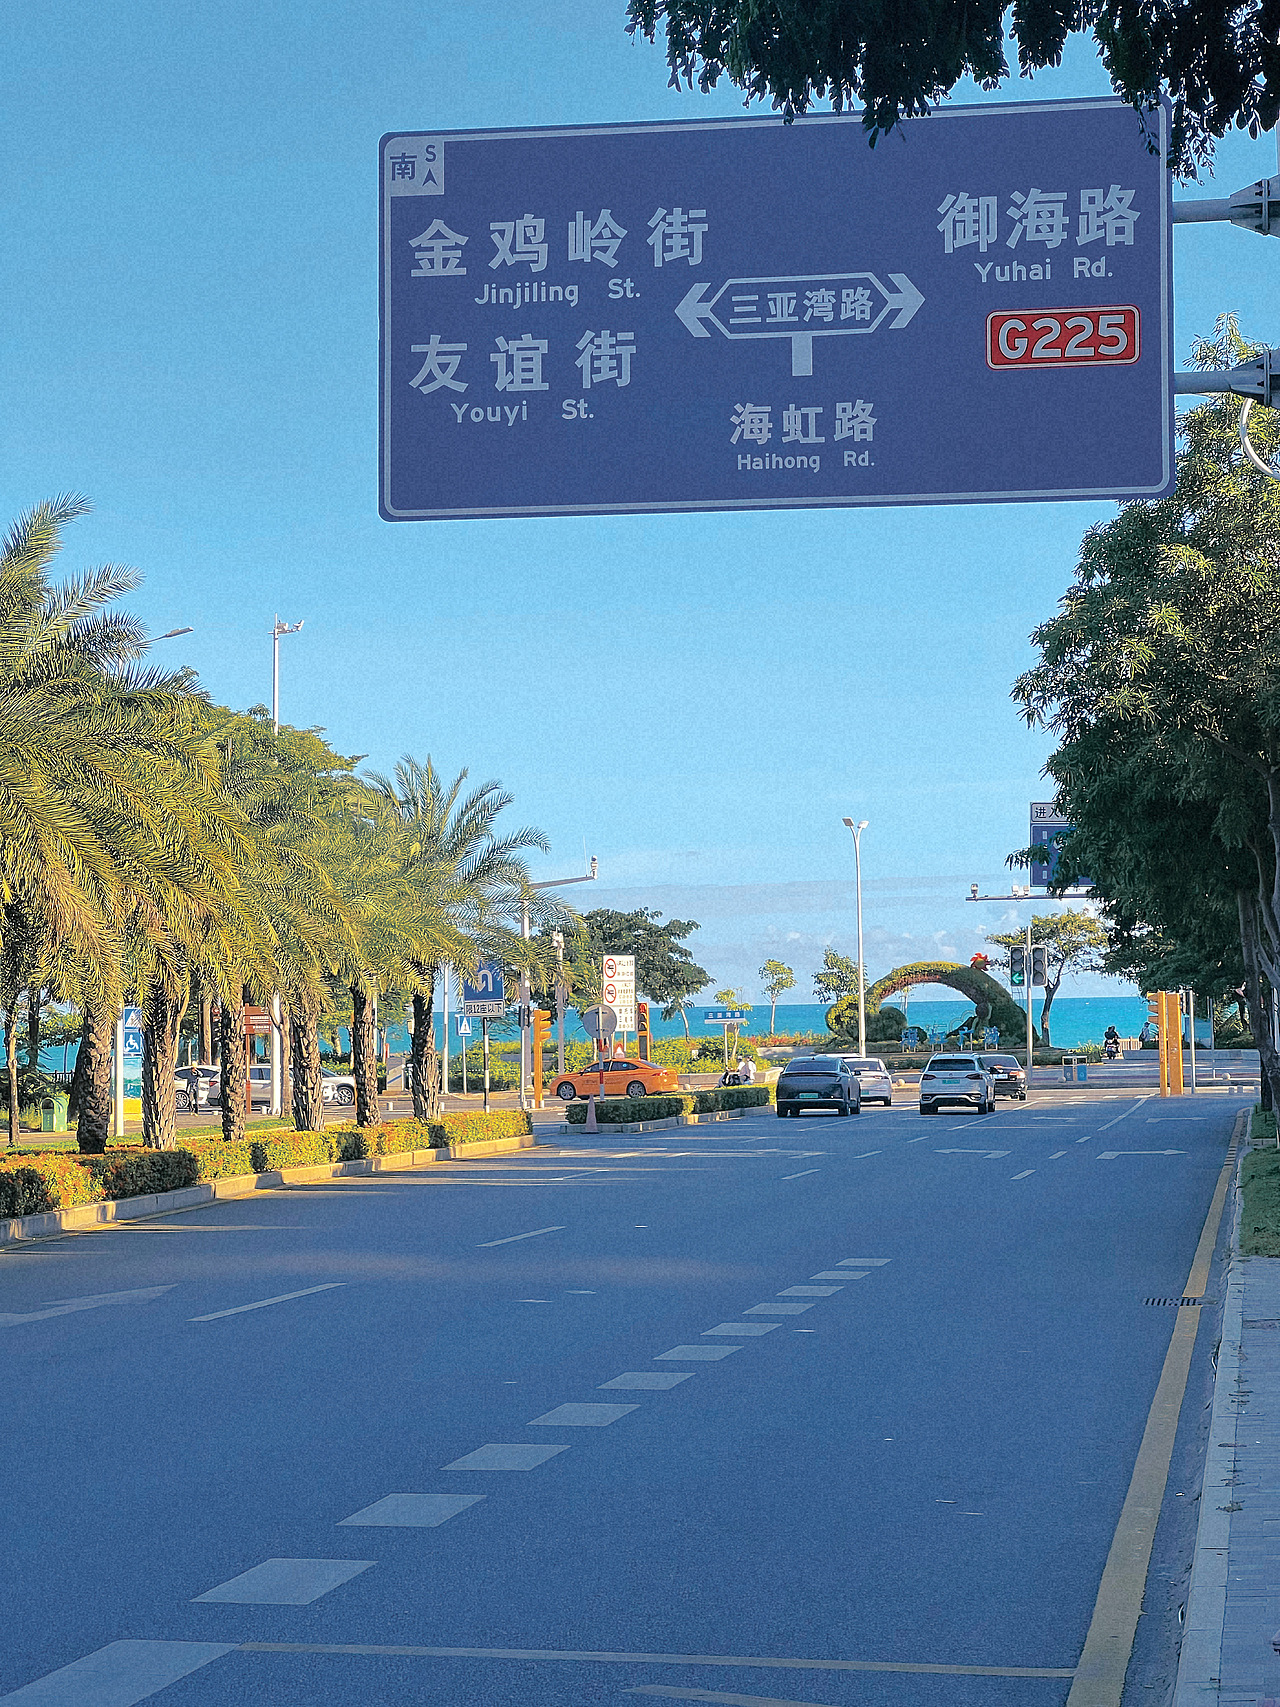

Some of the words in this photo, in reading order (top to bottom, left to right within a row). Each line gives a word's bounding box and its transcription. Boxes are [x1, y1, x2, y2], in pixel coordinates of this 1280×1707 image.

[389, 152, 417, 181] 南
[425, 144, 437, 163] S
[936, 184, 1141, 254] 御海路
[408, 207, 709, 278] 金鸡岭街
[973, 257, 1051, 283] Yuhai
[1073, 255, 1113, 279] Rd.
[474, 281, 579, 309] Jinjiling
[607, 277, 641, 300] St.
[728, 285, 875, 326] 三亚湾路
[998, 314, 1129, 360] G225
[408, 329, 637, 395] 友谊街
[450, 400, 528, 427] Youyi
[561, 398, 595, 420] St.
[729, 399, 878, 445] 海虹路
[737, 452, 820, 474] Haihong
[843, 450, 875, 467] Rd.
